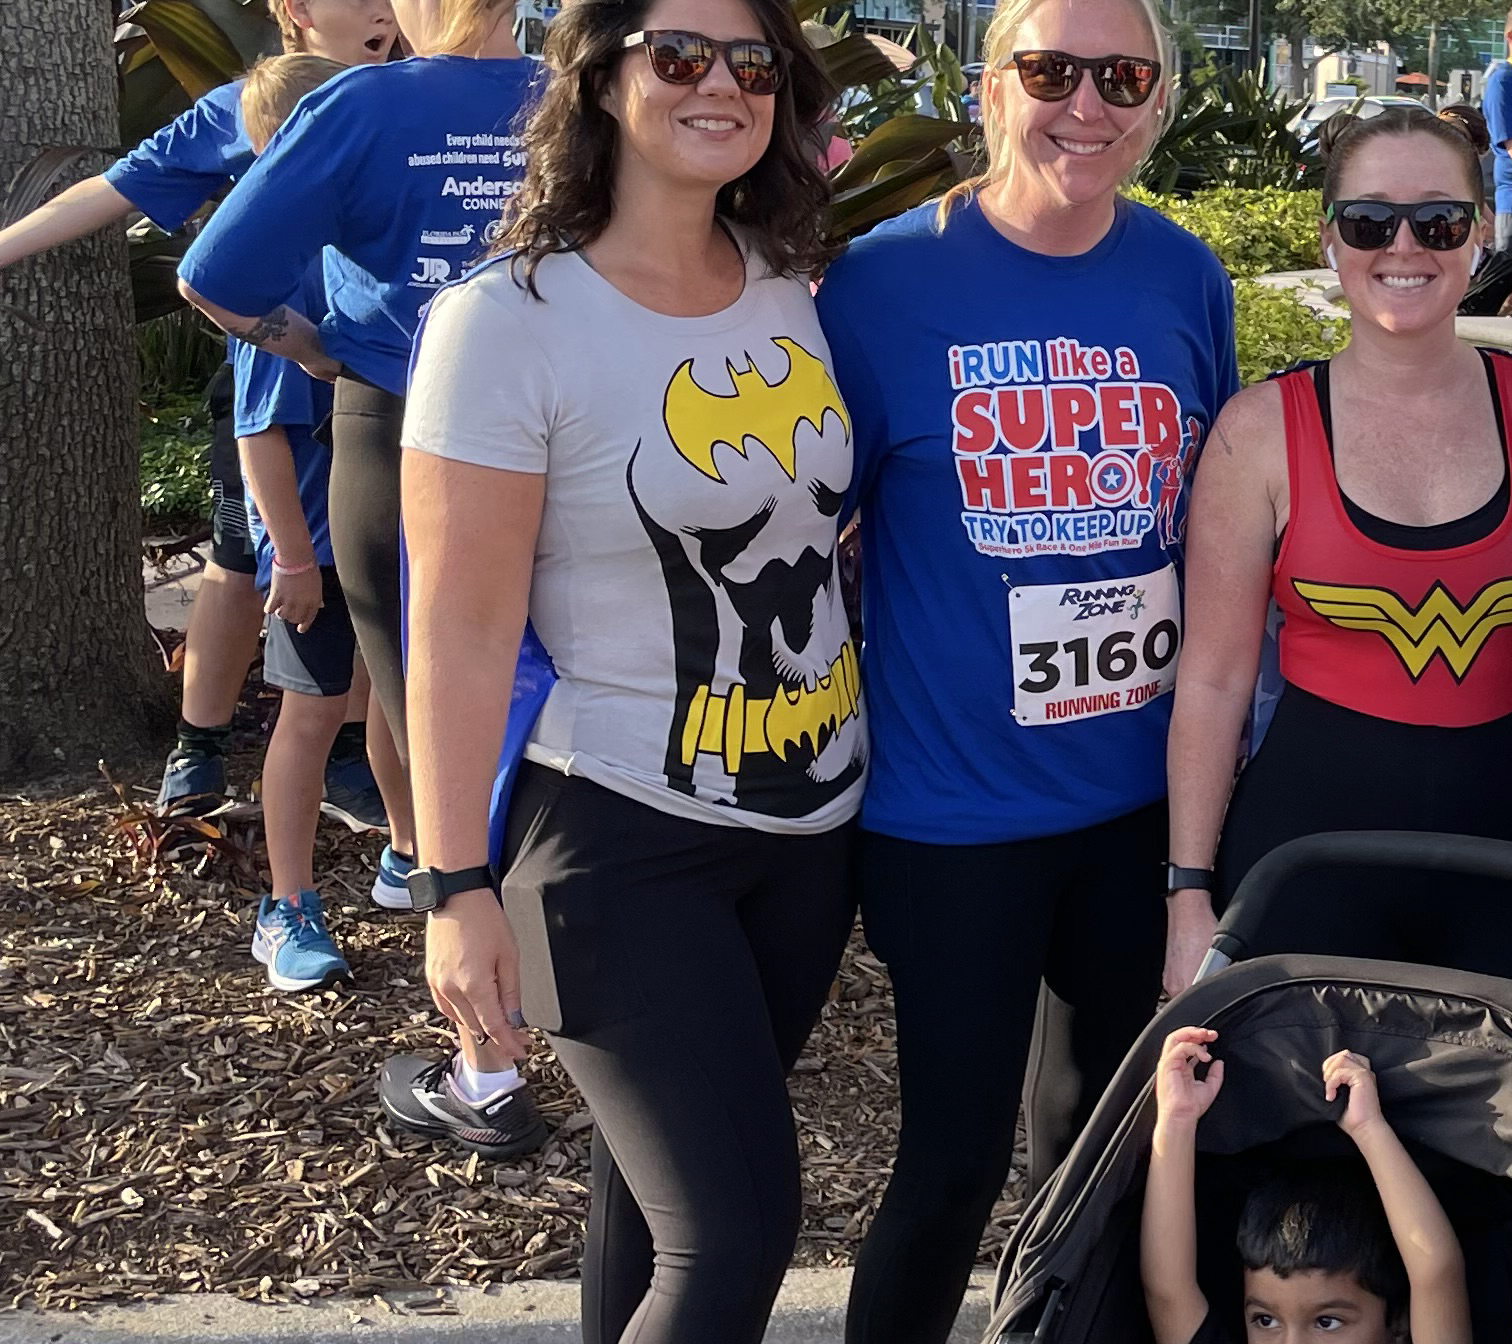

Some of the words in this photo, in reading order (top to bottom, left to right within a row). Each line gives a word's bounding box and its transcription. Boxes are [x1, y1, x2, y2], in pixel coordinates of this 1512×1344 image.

[446, 133, 471, 149] Every
[471, 134, 493, 147] child
[408, 151, 442, 167] abused
[442, 151, 478, 165] children
[478, 152, 500, 165] need
[951, 342, 1041, 387] iRUN
[1049, 340, 1110, 378] like
[1119, 350, 1138, 376] a
[954, 387, 1179, 454] SUPER
[963, 516, 1013, 544] TRY
[1016, 515, 1047, 542] TO
[1055, 512, 1112, 541] KEEP
[1119, 512, 1152, 536] UP
[978, 542, 1023, 555] Superhero
[1035, 543, 1058, 552] Race
[1068, 543, 1087, 552] One
[1103, 538, 1120, 547] Fun
[1121, 537, 1139, 547] Run
[1058, 584, 1136, 607] RUNNING
[1072, 599, 1127, 621] ZONE
[1018, 618, 1179, 694] 3160
[1045, 691, 1121, 720] RUNNING
[1125, 679, 1162, 706] ZONE
